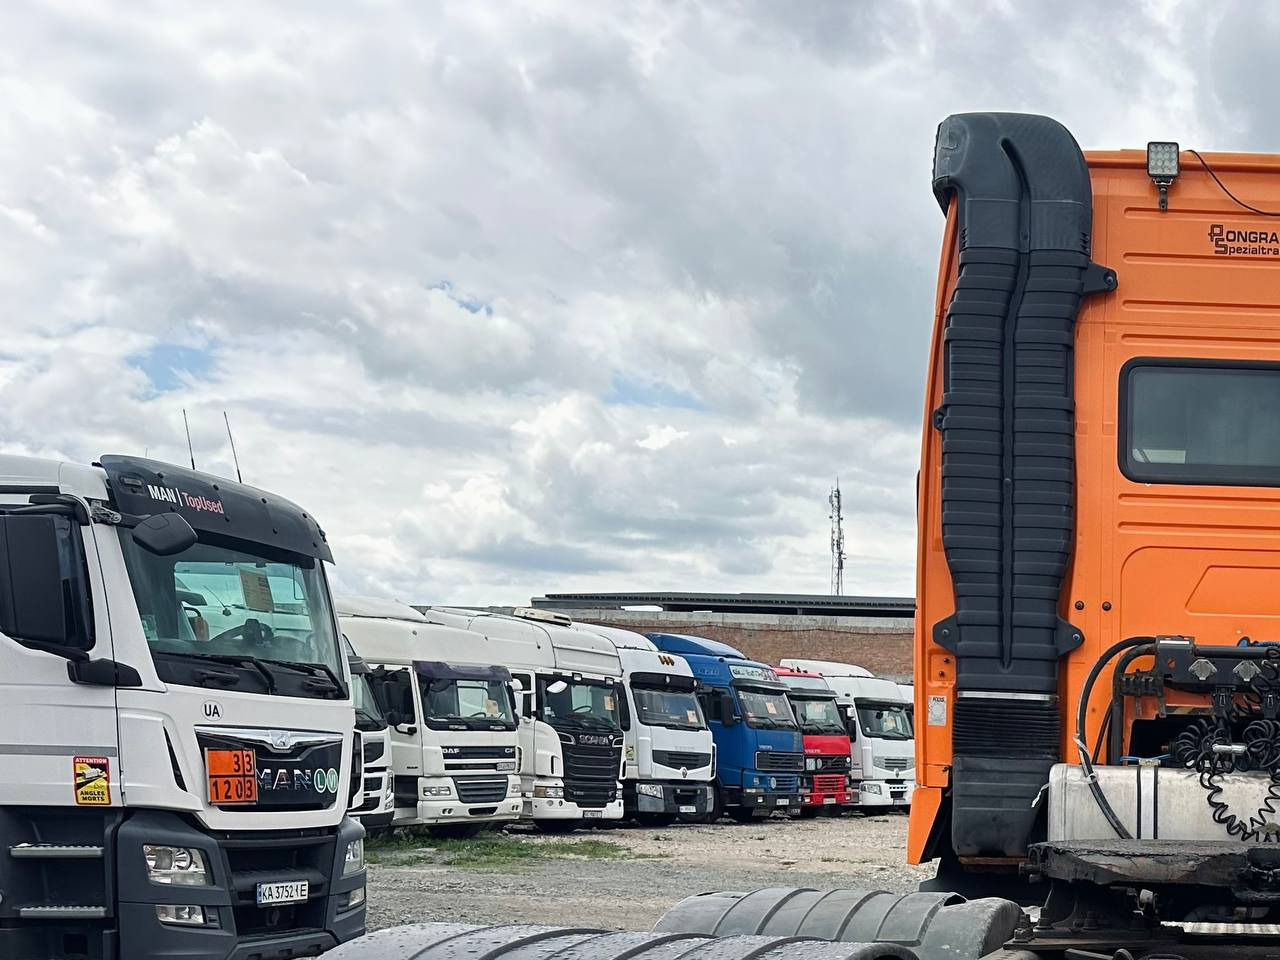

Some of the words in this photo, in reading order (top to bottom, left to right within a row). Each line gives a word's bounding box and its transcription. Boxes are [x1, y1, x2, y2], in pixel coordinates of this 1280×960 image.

[147, 484, 177, 504] MAN
[181, 491, 224, 514] TopUsed
[203, 703, 221, 718] UA
[232, 753, 253, 774] 33
[211, 779, 253, 800] 1203
